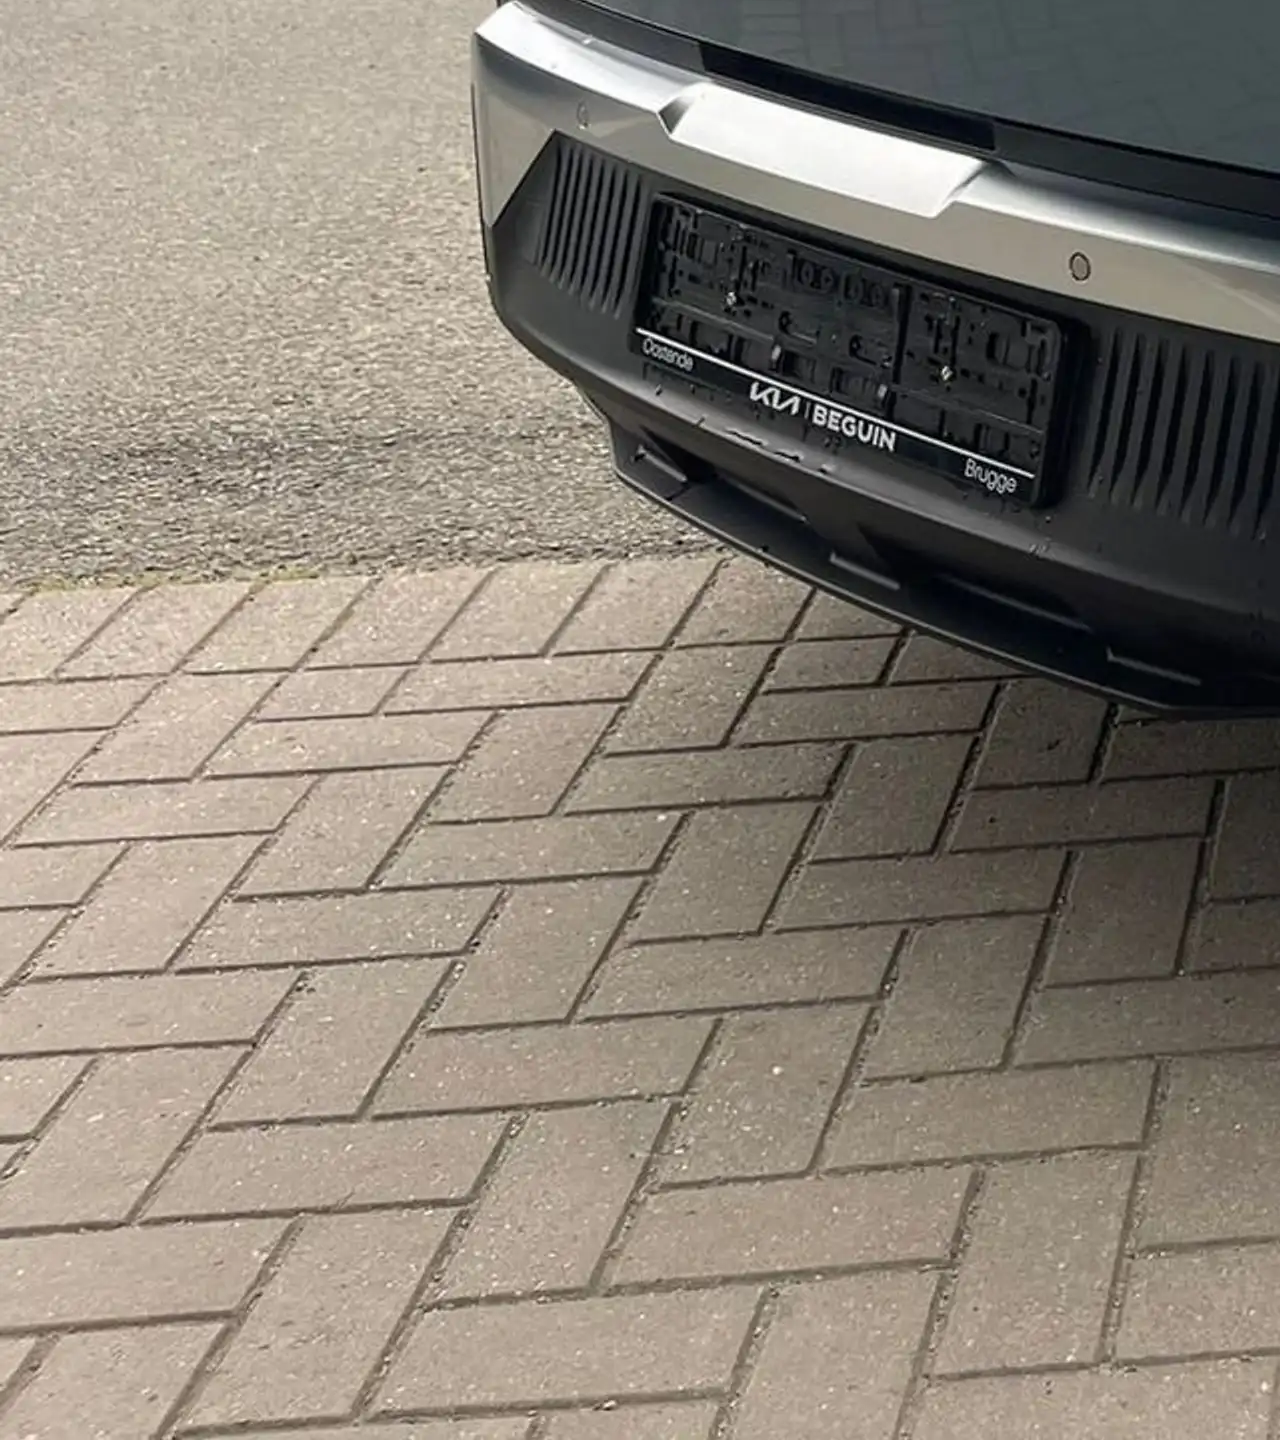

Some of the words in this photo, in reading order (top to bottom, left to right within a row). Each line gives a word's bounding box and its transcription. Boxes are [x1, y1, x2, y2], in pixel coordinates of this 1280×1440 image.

[750, 381, 800, 416] KIA
[811, 403, 897, 452] BEGUIN
[964, 458, 1017, 494] Brugge
